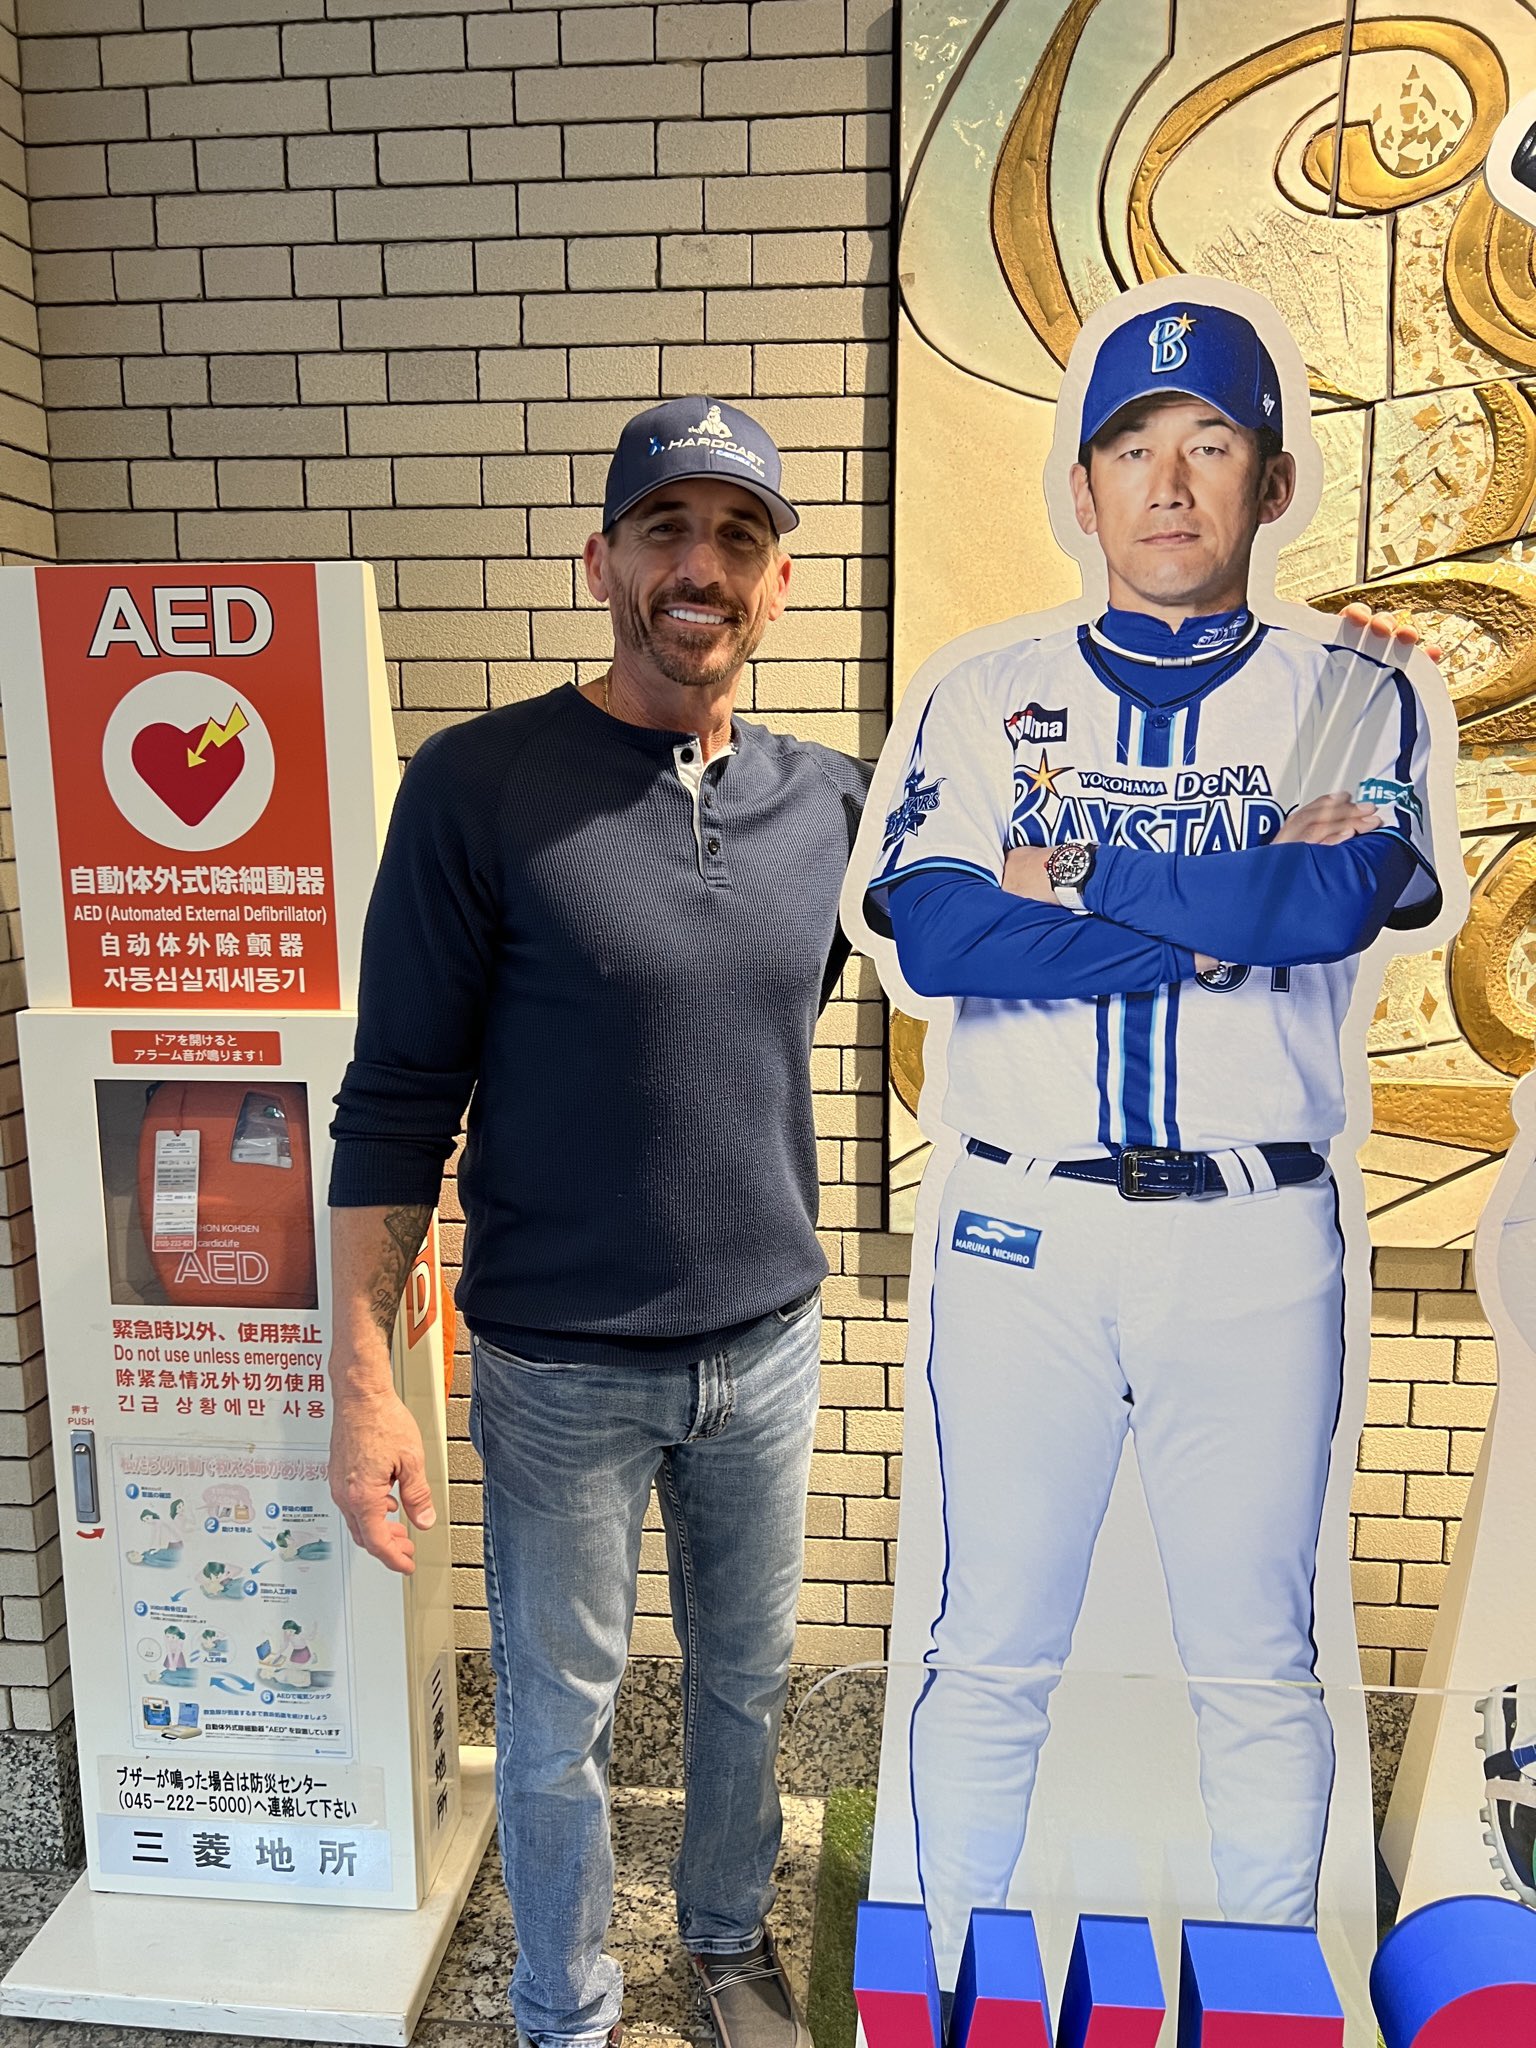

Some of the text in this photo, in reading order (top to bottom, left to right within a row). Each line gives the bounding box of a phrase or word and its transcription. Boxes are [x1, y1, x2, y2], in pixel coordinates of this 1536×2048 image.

[668, 437, 766, 467] HARDCAST
[88, 586, 274, 658] AED
[1079, 765, 1273, 800] YOKOHAMA DeNA
[70, 866, 325, 896] 自動体外式除細動器
[74, 905, 327, 926] AED (Automated External Defibrillator)
[101, 932, 304, 957] 自动体外除颤器
[104, 966, 306, 993] 자동심실제세동기
[155, 1034, 238, 1047] ドアを開けると
[221, 1224, 260, 1233] KOHDEN
[955, 1239, 1030, 1265] MARUHA NICHIRO
[174, 1250, 269, 1285] AED
[112, 1319, 323, 1344] 緊急時以外、使用禁止
[113, 1345, 323, 1370] Do not use unless emergency
[117, 1395, 326, 1418] 긴급 상황에만 사용
[67, 1417, 95, 1426] PUSH
[117, 1767, 328, 1795] ブザーが鳴った場合は防災センター
[132, 1830, 358, 1877] 三菱地所
